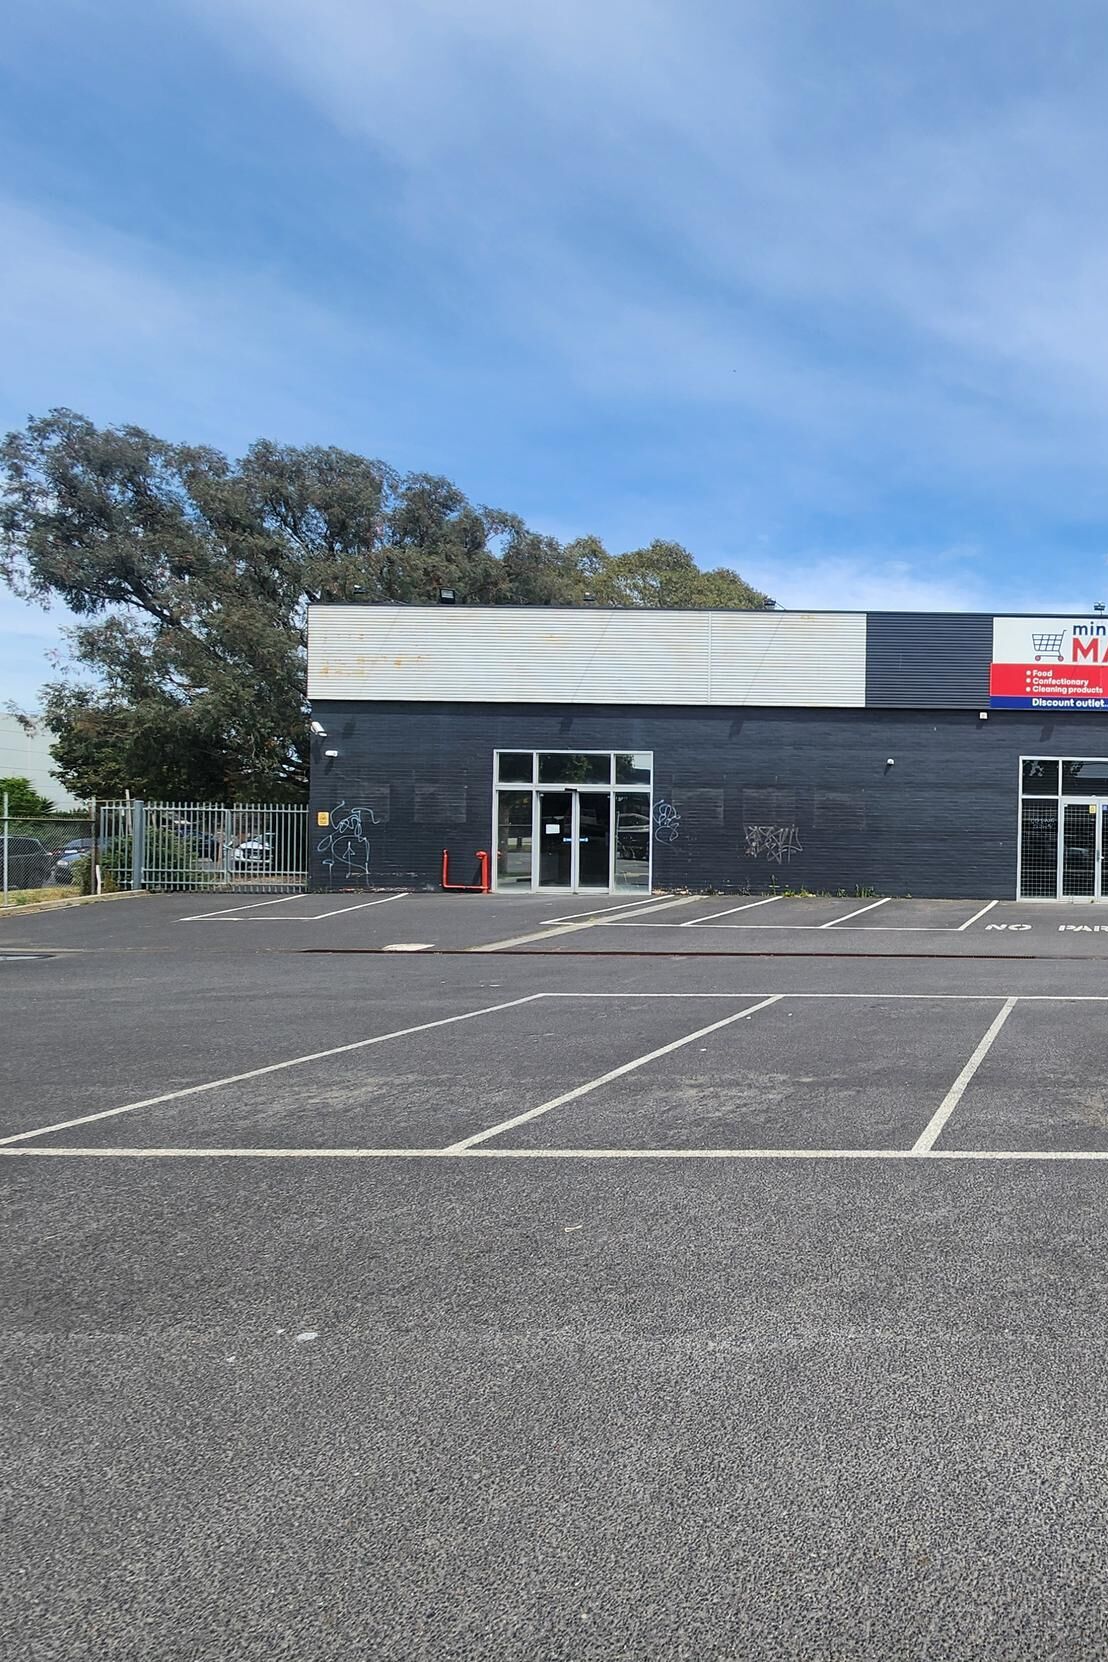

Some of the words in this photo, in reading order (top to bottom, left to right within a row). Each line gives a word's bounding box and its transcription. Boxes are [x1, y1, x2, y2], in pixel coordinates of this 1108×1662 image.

[1032, 678, 1089, 686] Confectionary
[1032, 686, 1067, 694] Cleaning
[1032, 698, 1074, 707] Discount
